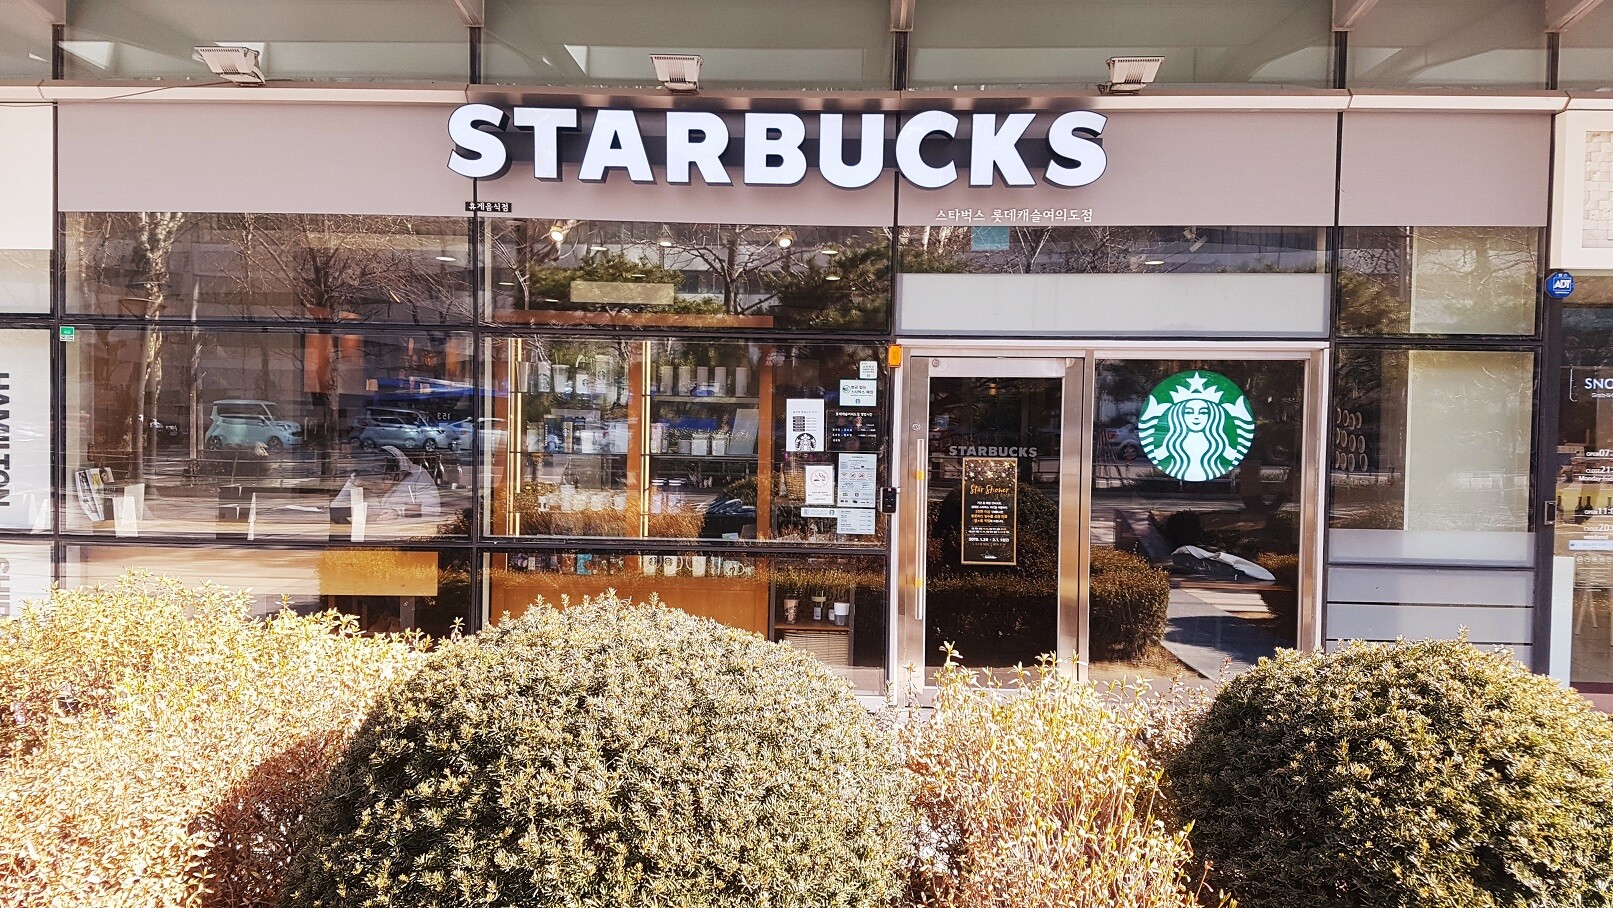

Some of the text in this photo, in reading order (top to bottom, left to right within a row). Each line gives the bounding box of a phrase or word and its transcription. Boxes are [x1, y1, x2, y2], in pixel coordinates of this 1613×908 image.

[447, 102, 1108, 189] STARBUCKS
[468, 202, 509, 212] 휴게음식점
[934, 208, 1093, 223] 스타벅스 롯데캐슬여의도점
[1553, 279, 1571, 289] ADT
[949, 445, 1038, 458] STARBUCKS
[970, 484, 985, 495] Star
